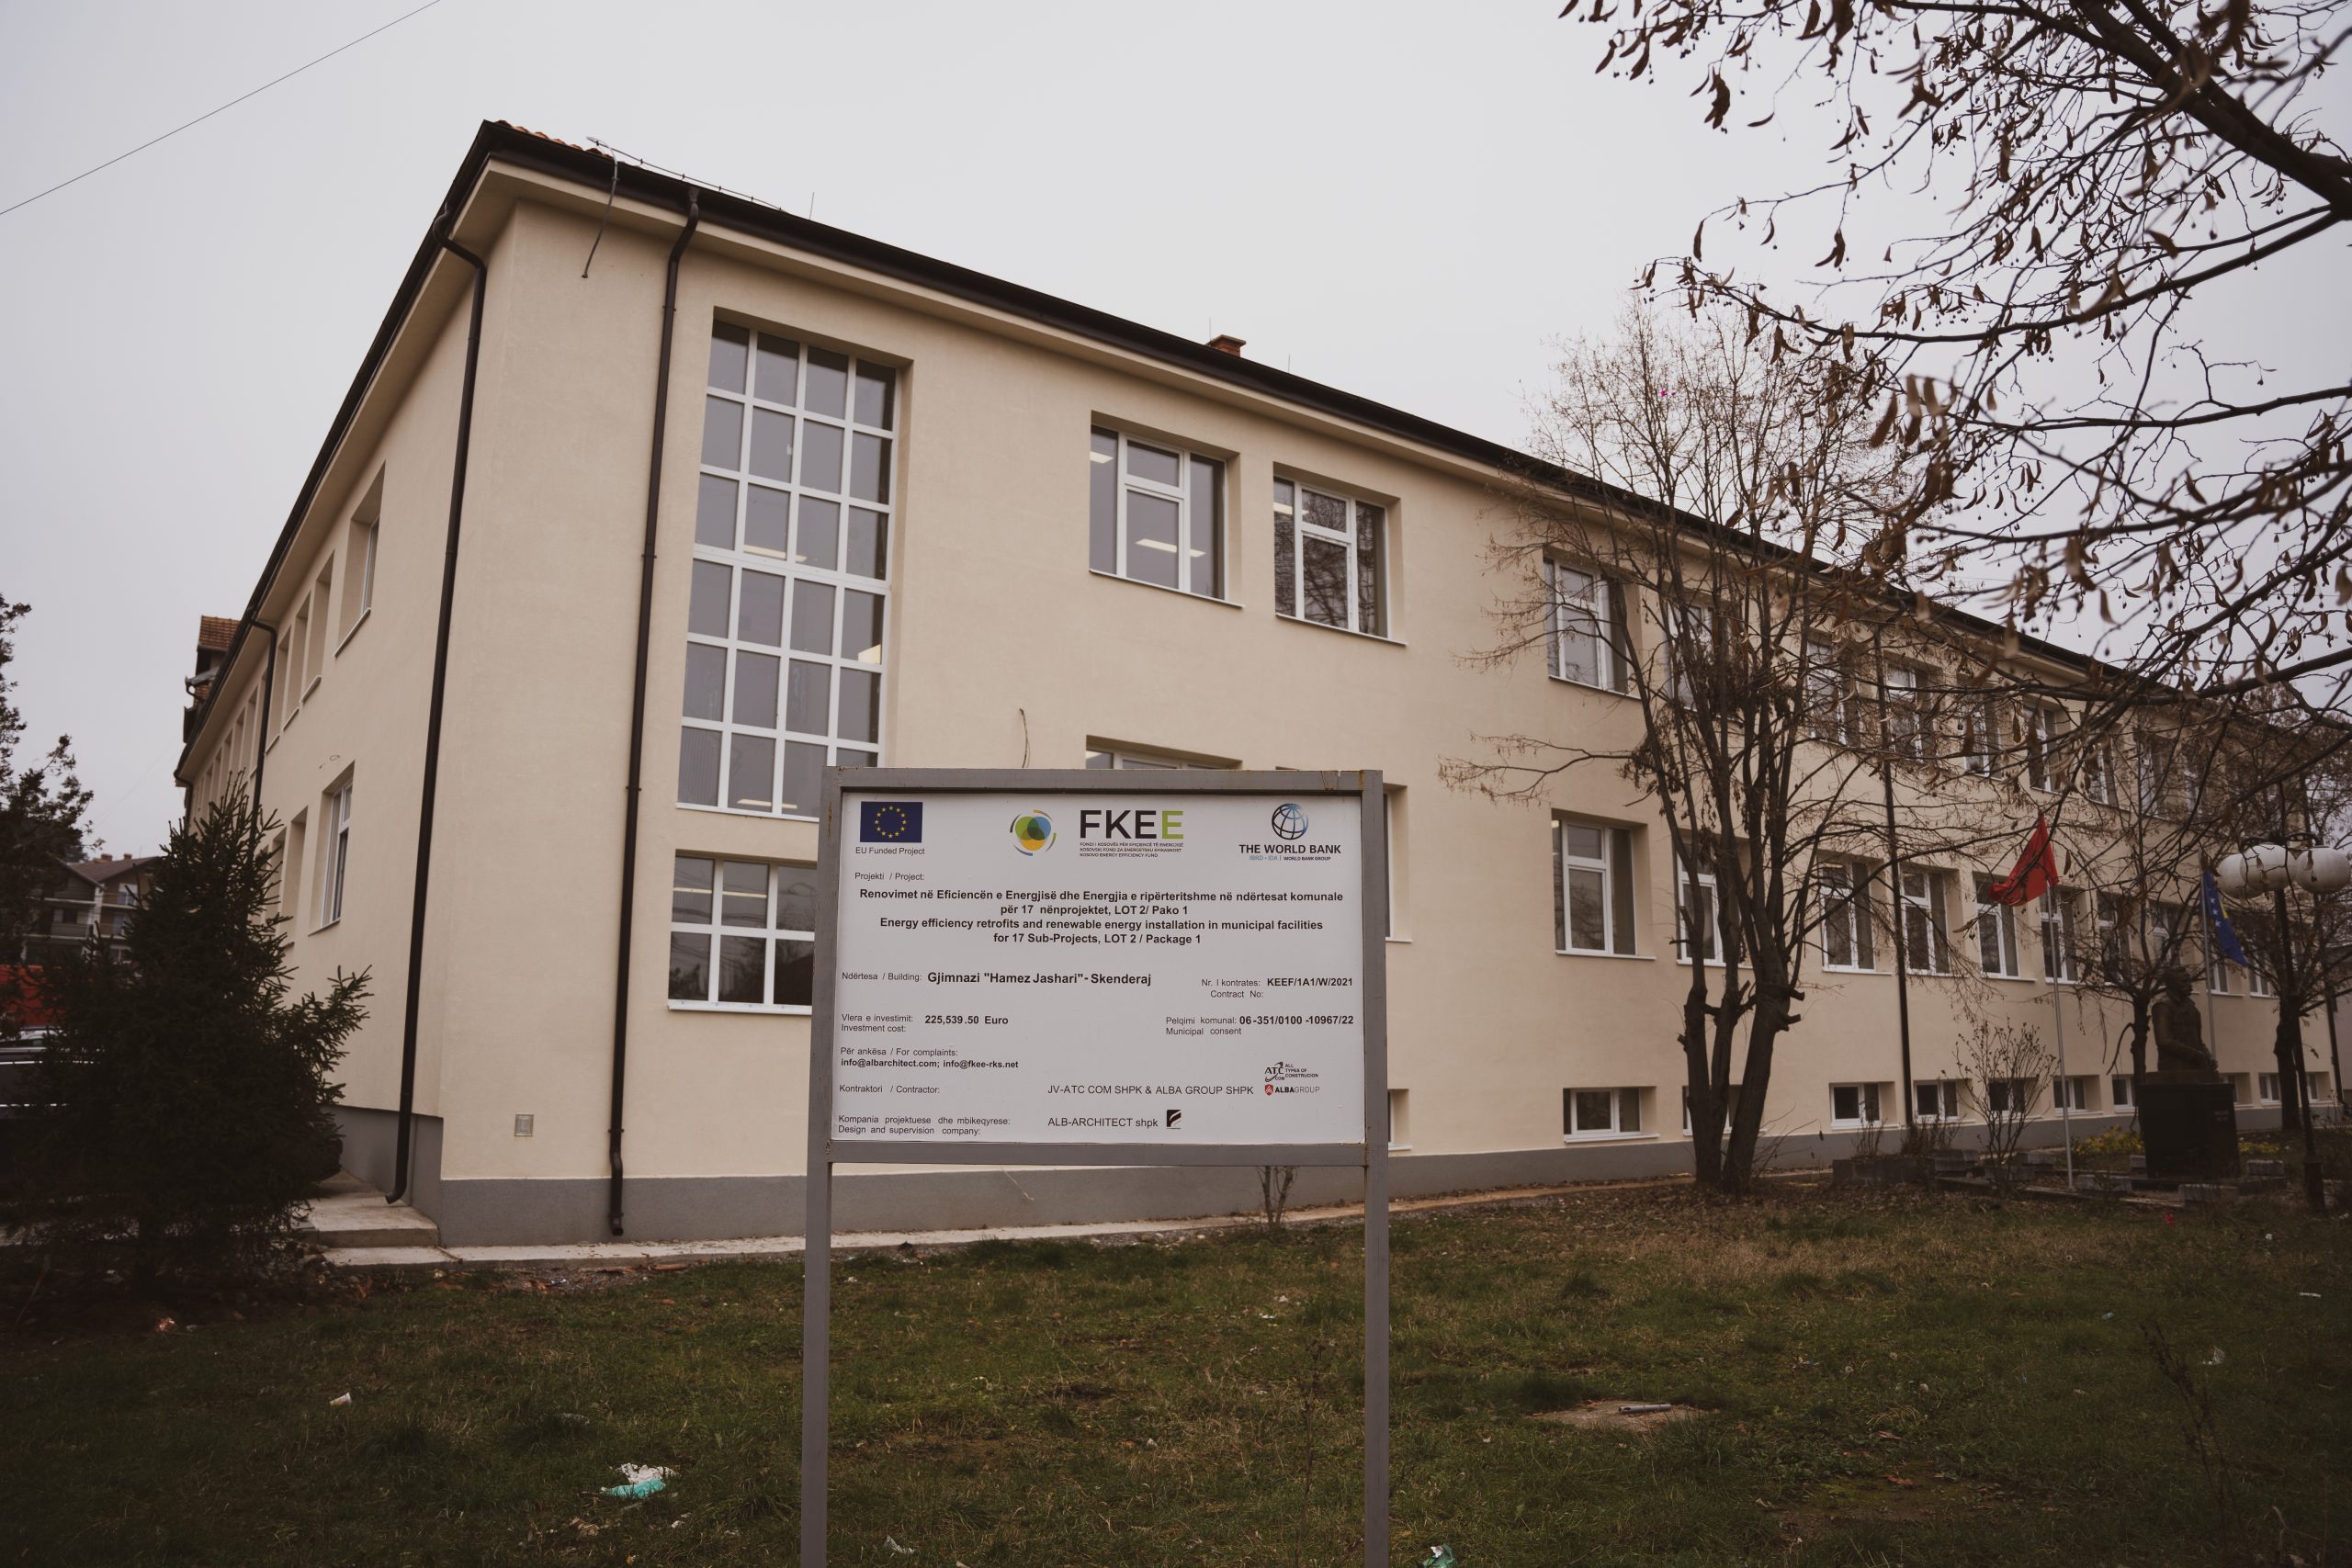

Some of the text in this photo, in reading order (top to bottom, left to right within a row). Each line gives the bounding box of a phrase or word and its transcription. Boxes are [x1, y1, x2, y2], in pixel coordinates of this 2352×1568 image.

[1080, 810, 1184, 839] FKEE
[855, 846, 866, 854] EU
[899, 847, 925, 855] Project
[1239, 844, 1341, 853] THE WORLD BANK
[854, 872, 884, 881] Projekti
[895, 873, 924, 882] Project:
[860, 889, 917, 899] Renovimet
[920, 890, 933, 899] në
[937, 889, 993, 899] Eficiencën
[1006, 890, 1057, 902] Energjisë
[1059, 890, 1080, 900] dhe
[1082, 890, 1127, 903] Energjia
[1130, 893, 1137, 901] e
[1140, 892, 1216, 903] ripërteritshme
[1220, 892, 1233, 901] në
[1236, 892, 1288, 901] ndërtesat
[1290, 892, 1343, 901] komunale
[1001, 905, 1018, 916] për
[1022, 905, 1034, 914] 17
[1040, 905, 1111, 916] nënprojektet,
[1114, 906, 1137, 915] LOT
[1152, 906, 1180, 915] Pako
[1182, 906, 1188, 915] 1
[880, 918, 1323, 932] Energy efficiency retrofits and renewable energy installation in municipal facilities
[994, 933, 1009, 942] for
[1012, 933, 1024, 942] 17
[1028, 933, 1101, 945] Sub-Projects,
[1104, 934, 1128, 943] LOT
[1130, 935, 1136, 943] 2
[1147, 935, 1192, 946] Package
[1195, 935, 1201, 943] 1
[842, 972, 878, 980] Ndërtesa
[888, 973, 922, 982] Building:
[928, 973, 980, 985] Gjimnazi
[984, 973, 1030, 983] "Hamez
[1091, 974, 1151, 987] Skenderaj
[1267, 977, 1352, 987] KEEF/1A1/W/2021
[1221, 978, 1261, 987] kontrates:
[1211, 990, 1263, 998] Contract No:
[874, 1014, 913, 1022] investimit:
[985, 1016, 1009, 1024] Euro
[1166, 1016, 1237, 1025] Pelqimi komunal:
[842, 1024, 885, 1032] Investment
[1166, 1027, 1241, 1036] Municipal consent
[857, 1047, 887, 1055] ankësa
[913, 1048, 957, 1057] complaints:
[841, 1059, 1018, 1069] info@albarchitect.com; info@fkee-rks.net
[839, 1085, 882, 1093] Kontraktori
[896, 1085, 940, 1094] Contractor:
[1088, 1085, 1112, 1095] COM
[1114, 1086, 1142, 1095] SHPK
[1146, 1086, 1152, 1095] &
[1156, 1086, 1182, 1095] ALBA
[1185, 1086, 1223, 1095] GROUP
[1226, 1086, 1253, 1095] SHPK
[839, 1115, 1010, 1126] Kompania projektuese dhe mbikeqyrese:
[1047, 1117, 1158, 1129] ALB-ARCHITECT shpk
[838, 1125, 980, 1135] Design and supervision company:
